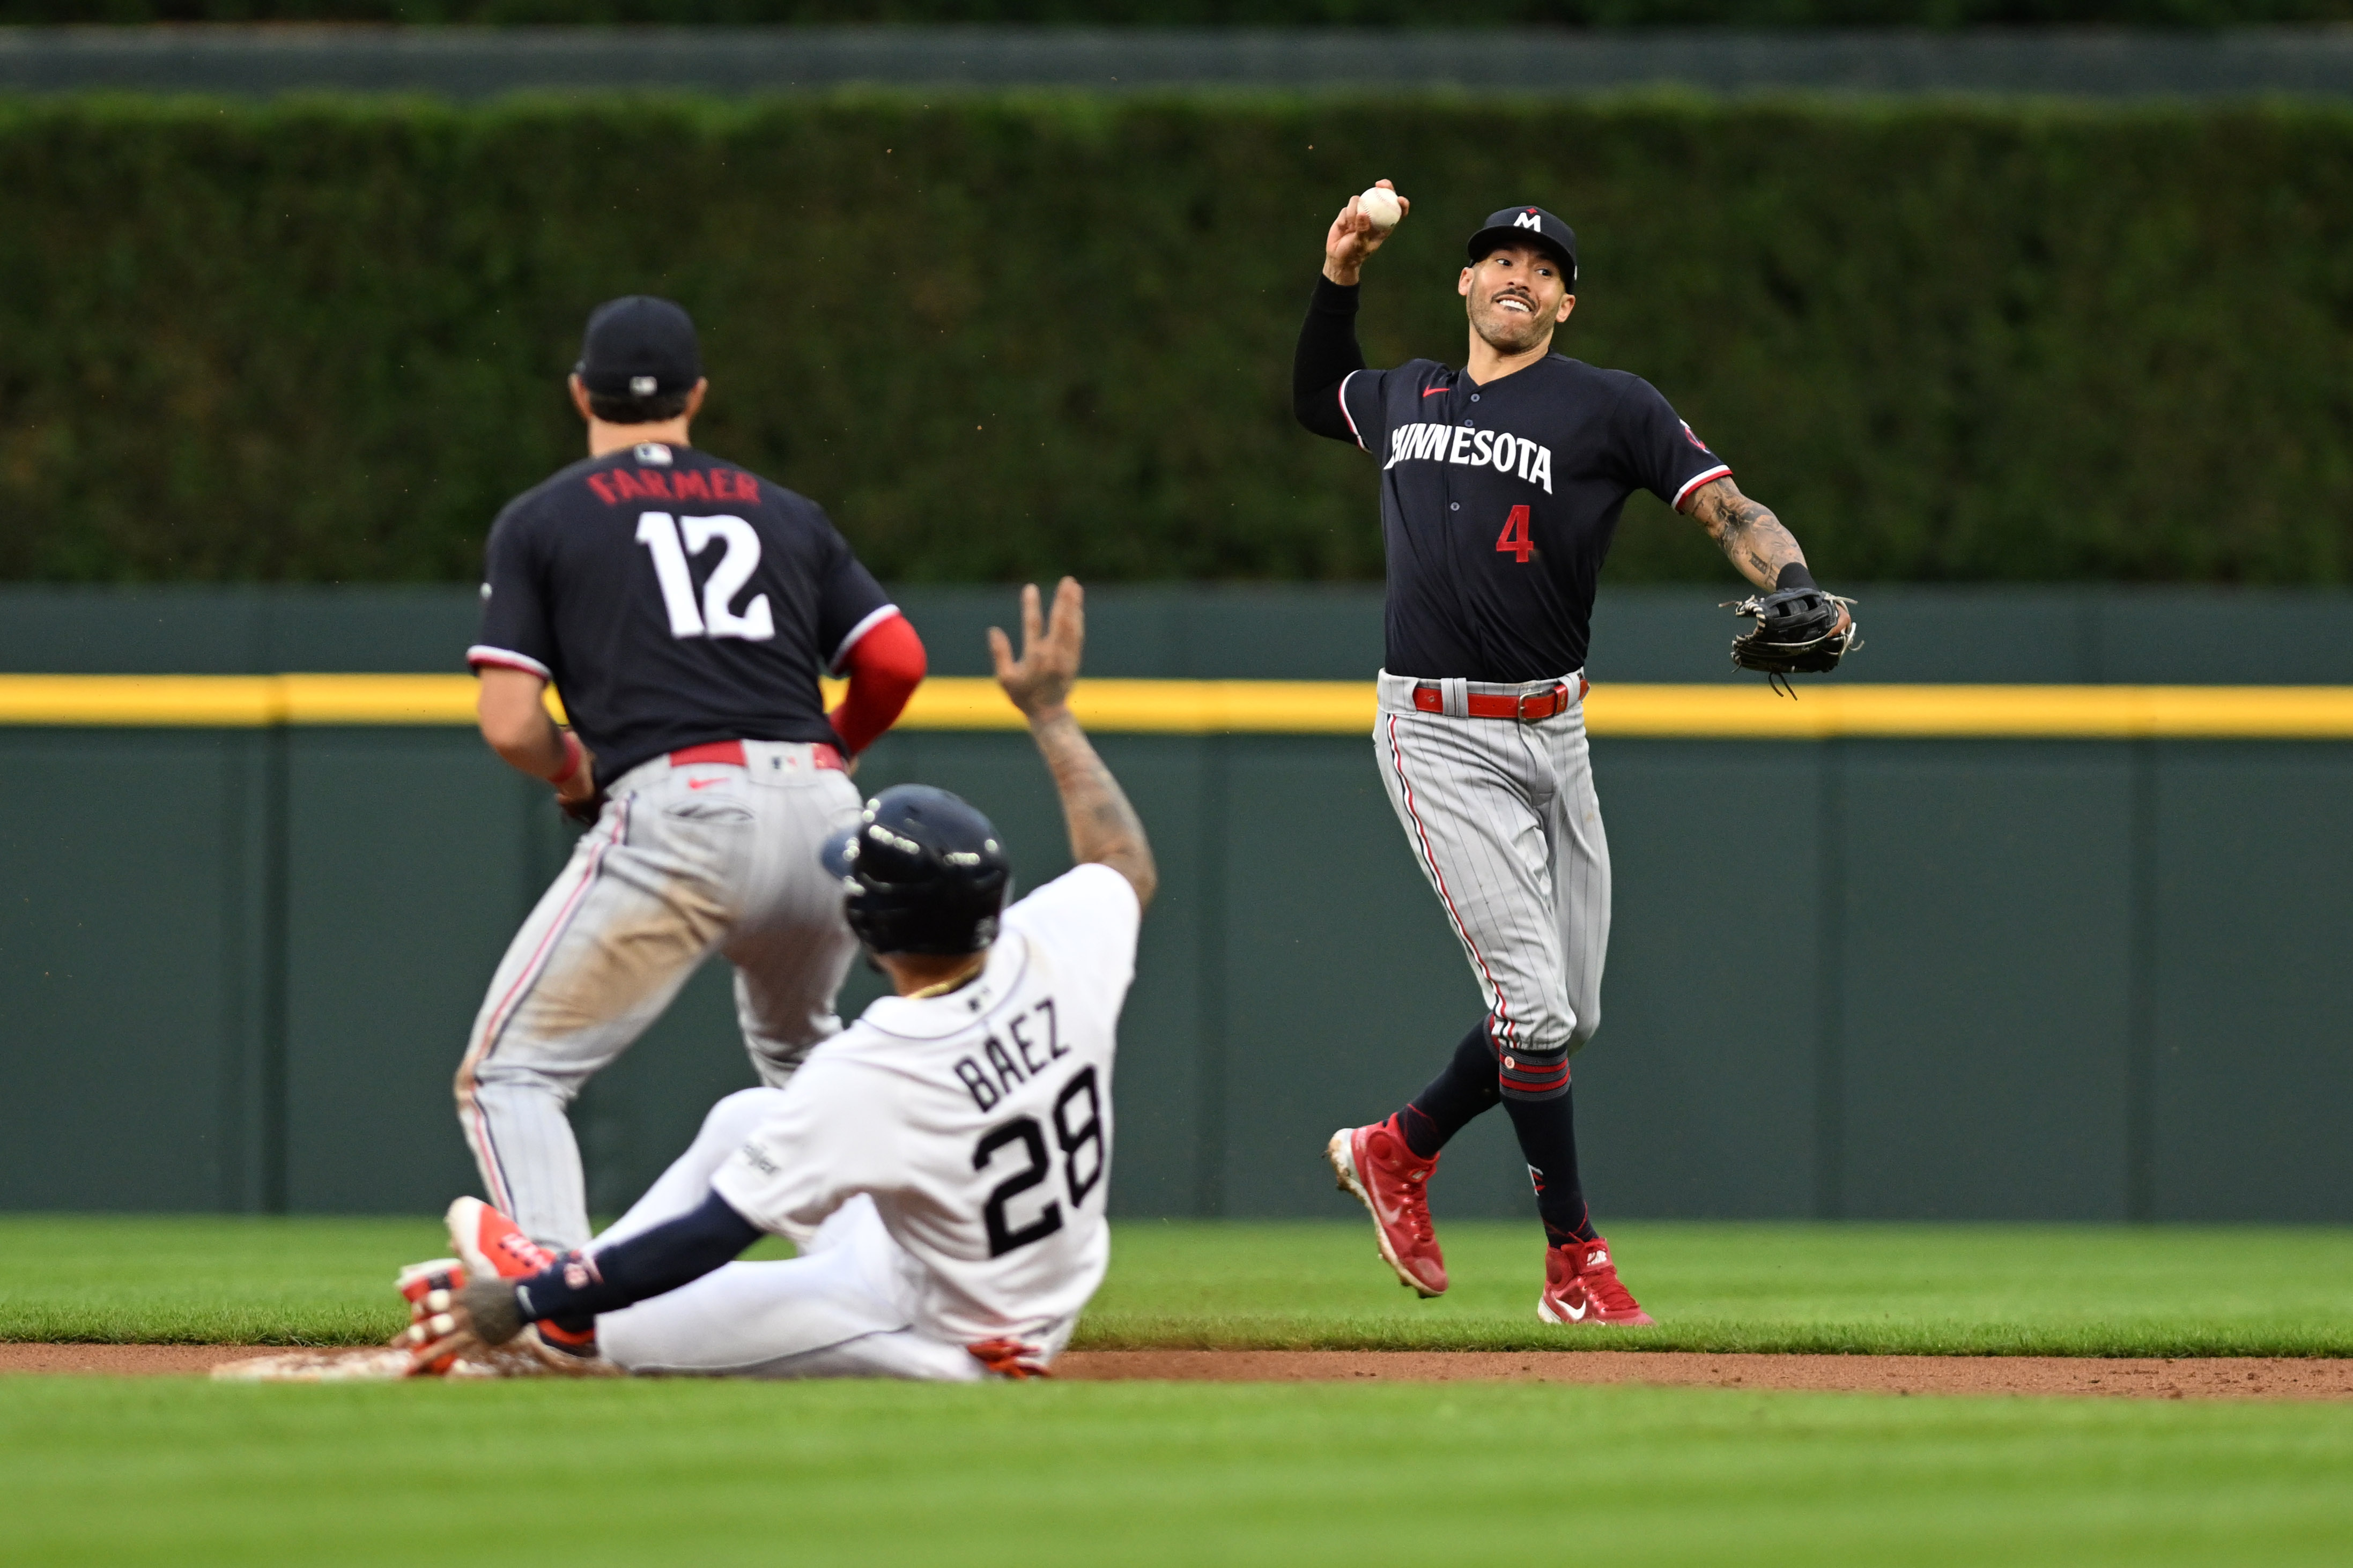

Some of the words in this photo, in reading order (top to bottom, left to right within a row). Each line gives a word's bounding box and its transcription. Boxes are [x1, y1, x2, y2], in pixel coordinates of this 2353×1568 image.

[1513, 212, 1541, 233] M
[587, 467, 760, 507] FARMER
[634, 511, 775, 640] 12
[1496, 504, 1534, 563] 4
[954, 997, 1070, 1113] BAEZ
[972, 1064, 1103, 1258] 28
